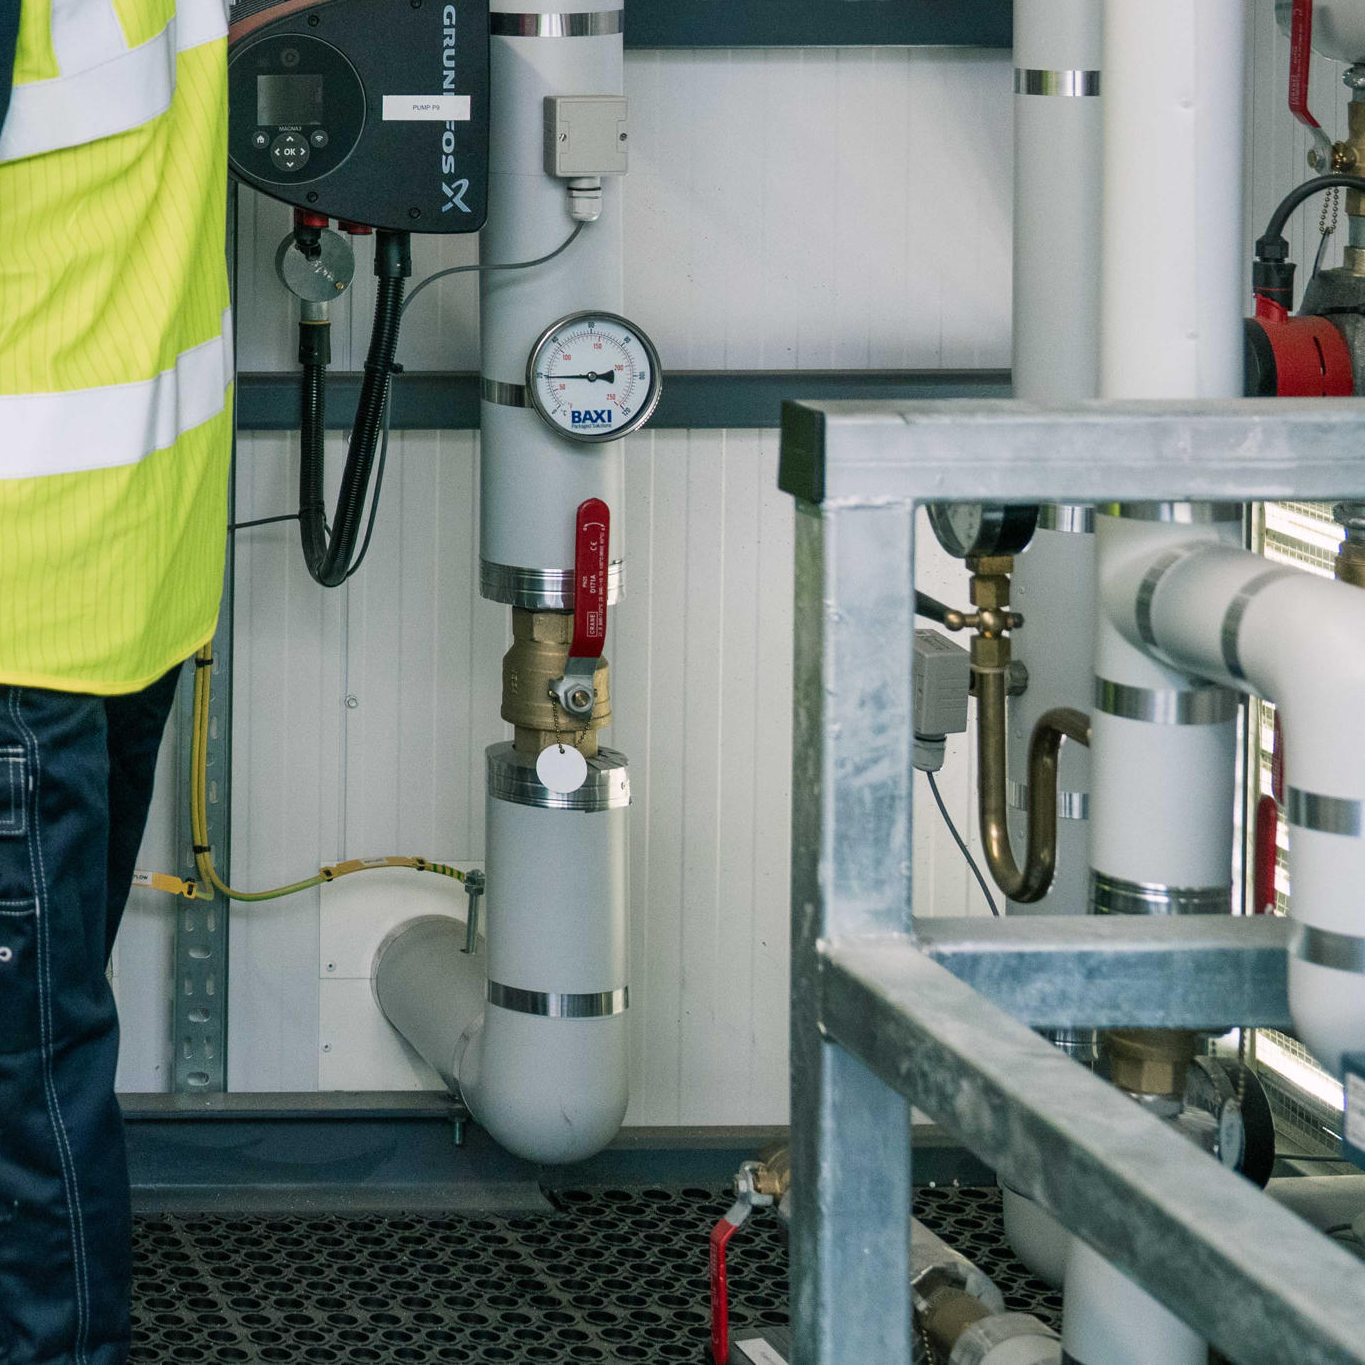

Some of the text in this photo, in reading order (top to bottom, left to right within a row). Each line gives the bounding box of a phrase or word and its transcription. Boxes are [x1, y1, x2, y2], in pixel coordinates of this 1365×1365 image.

[442, 4, 456, 175] GRUNFOS
[283, 148, 296, 156] OK
[571, 409, 612, 424] BAXI
